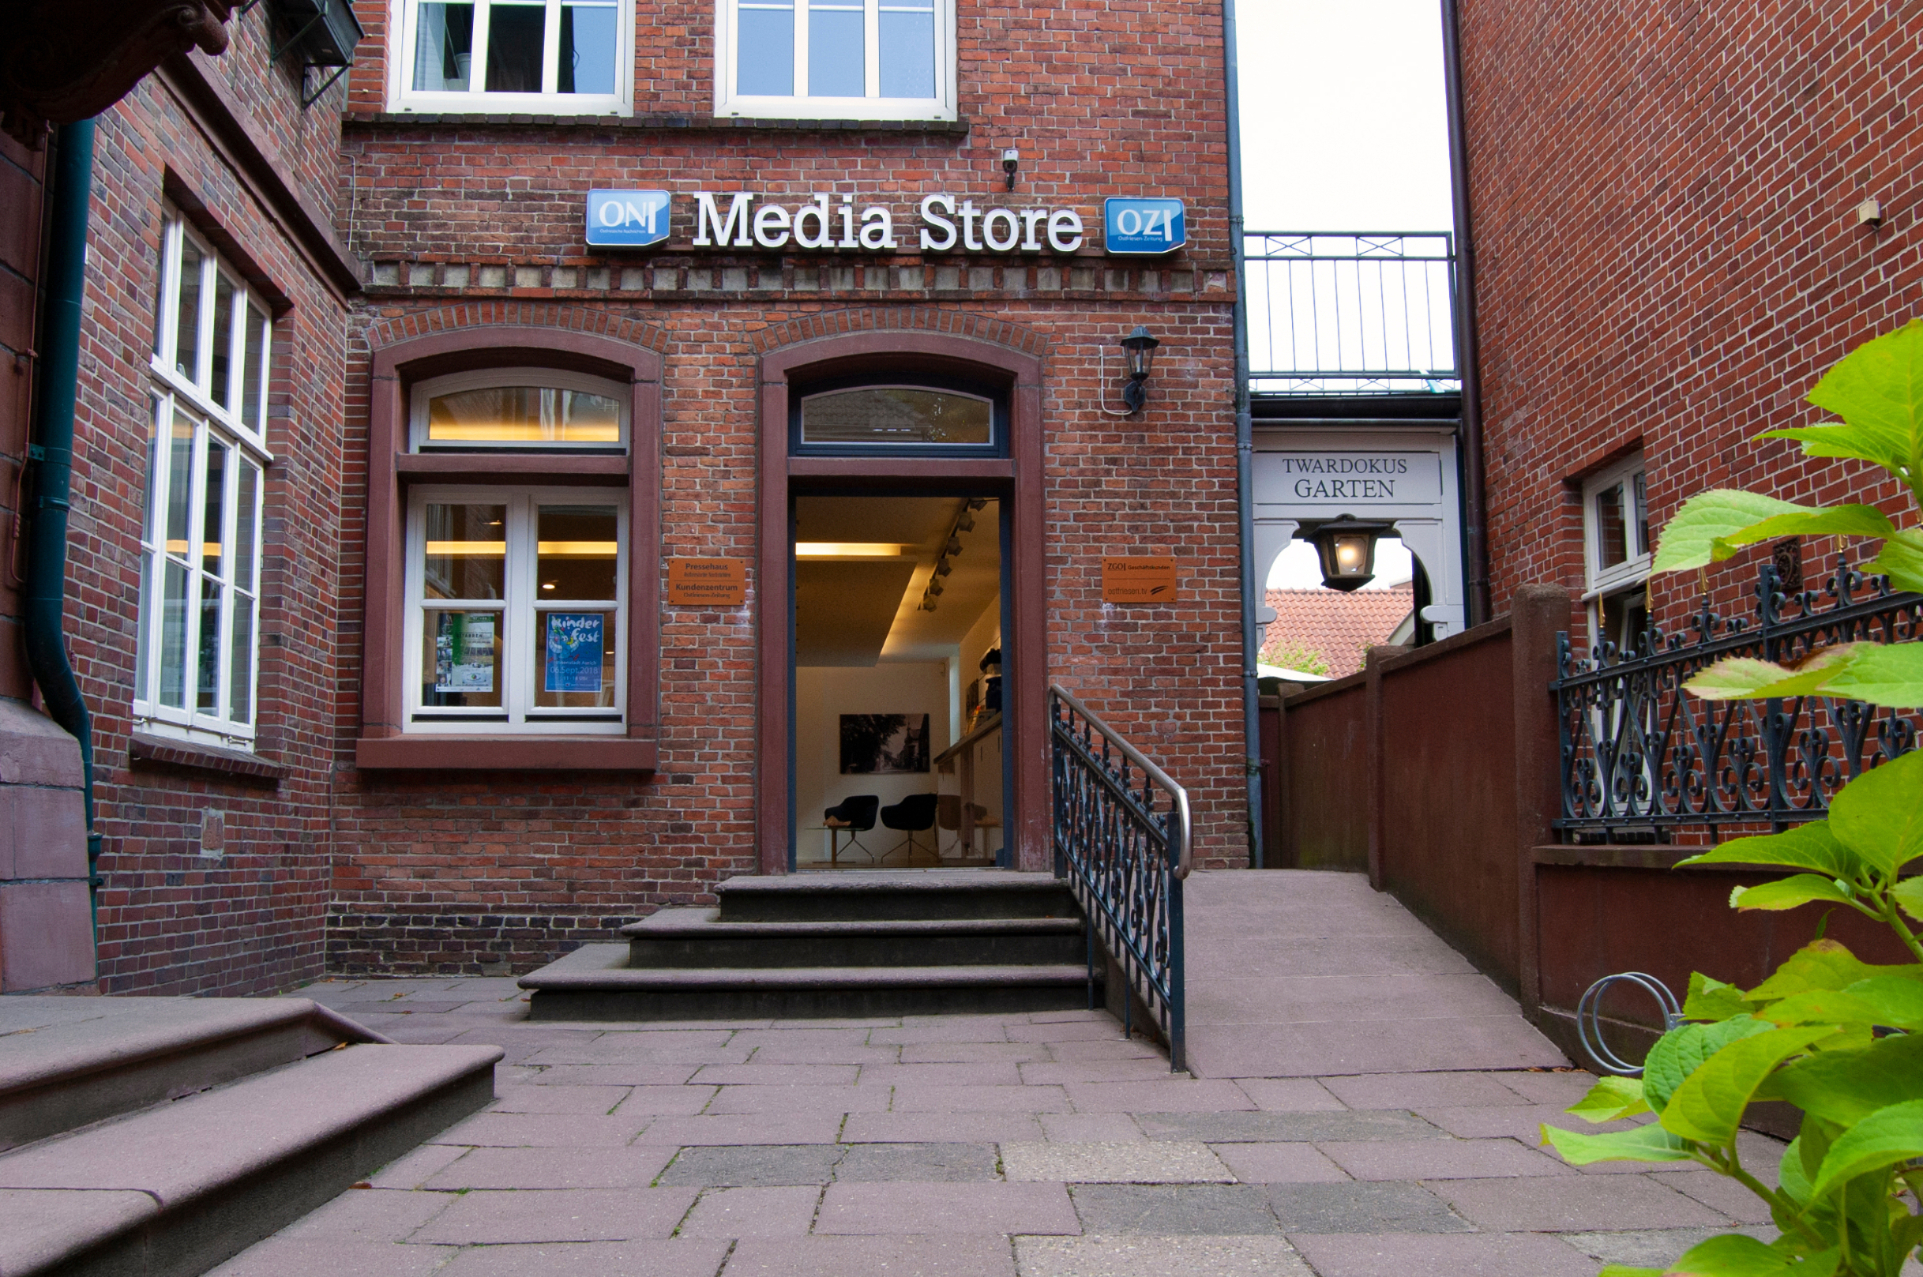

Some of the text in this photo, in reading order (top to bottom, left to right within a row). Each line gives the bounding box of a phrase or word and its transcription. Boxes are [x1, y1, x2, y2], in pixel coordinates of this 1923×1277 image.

[693, 191, 1084, 252] Media Store
[1282, 458, 1408, 474] TWARDOKUS
[1294, 479, 1396, 498] GARTEN
